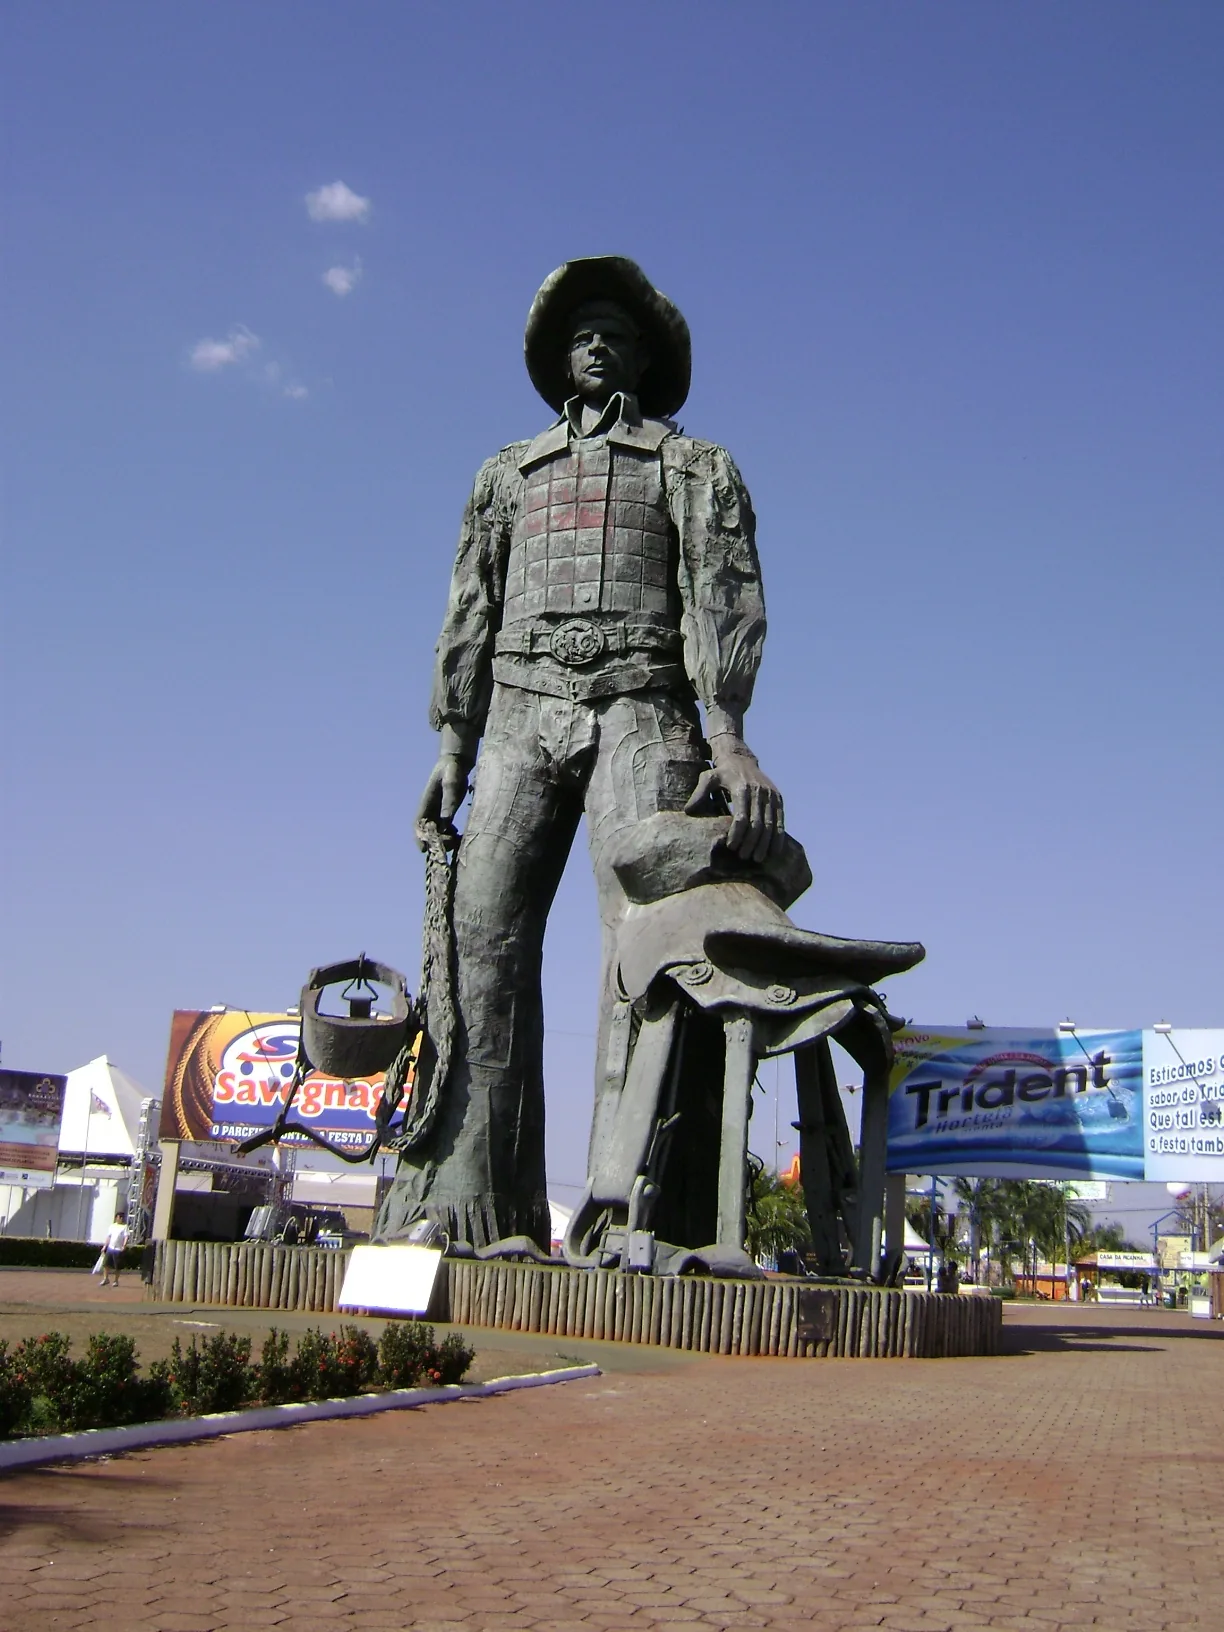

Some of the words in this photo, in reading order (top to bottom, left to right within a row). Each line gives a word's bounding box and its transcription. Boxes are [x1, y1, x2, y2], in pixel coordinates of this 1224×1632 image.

[1150, 1058, 1213, 1084] Esticamos
[906, 1050, 1111, 1129] Trident
[1150, 1090, 1178, 1105] sabor
[1182, 1087, 1195, 1101] de
[1150, 1112, 1171, 1128] Que
[1176, 1109, 1193, 1126] tal
[212, 1125, 220, 1135] O
[221, 1126, 265, 1137] PARCEI
[328, 1131, 362, 1143] FESTA
[1150, 1138, 1155, 1149] a
[1159, 1136, 1186, 1150] festa
